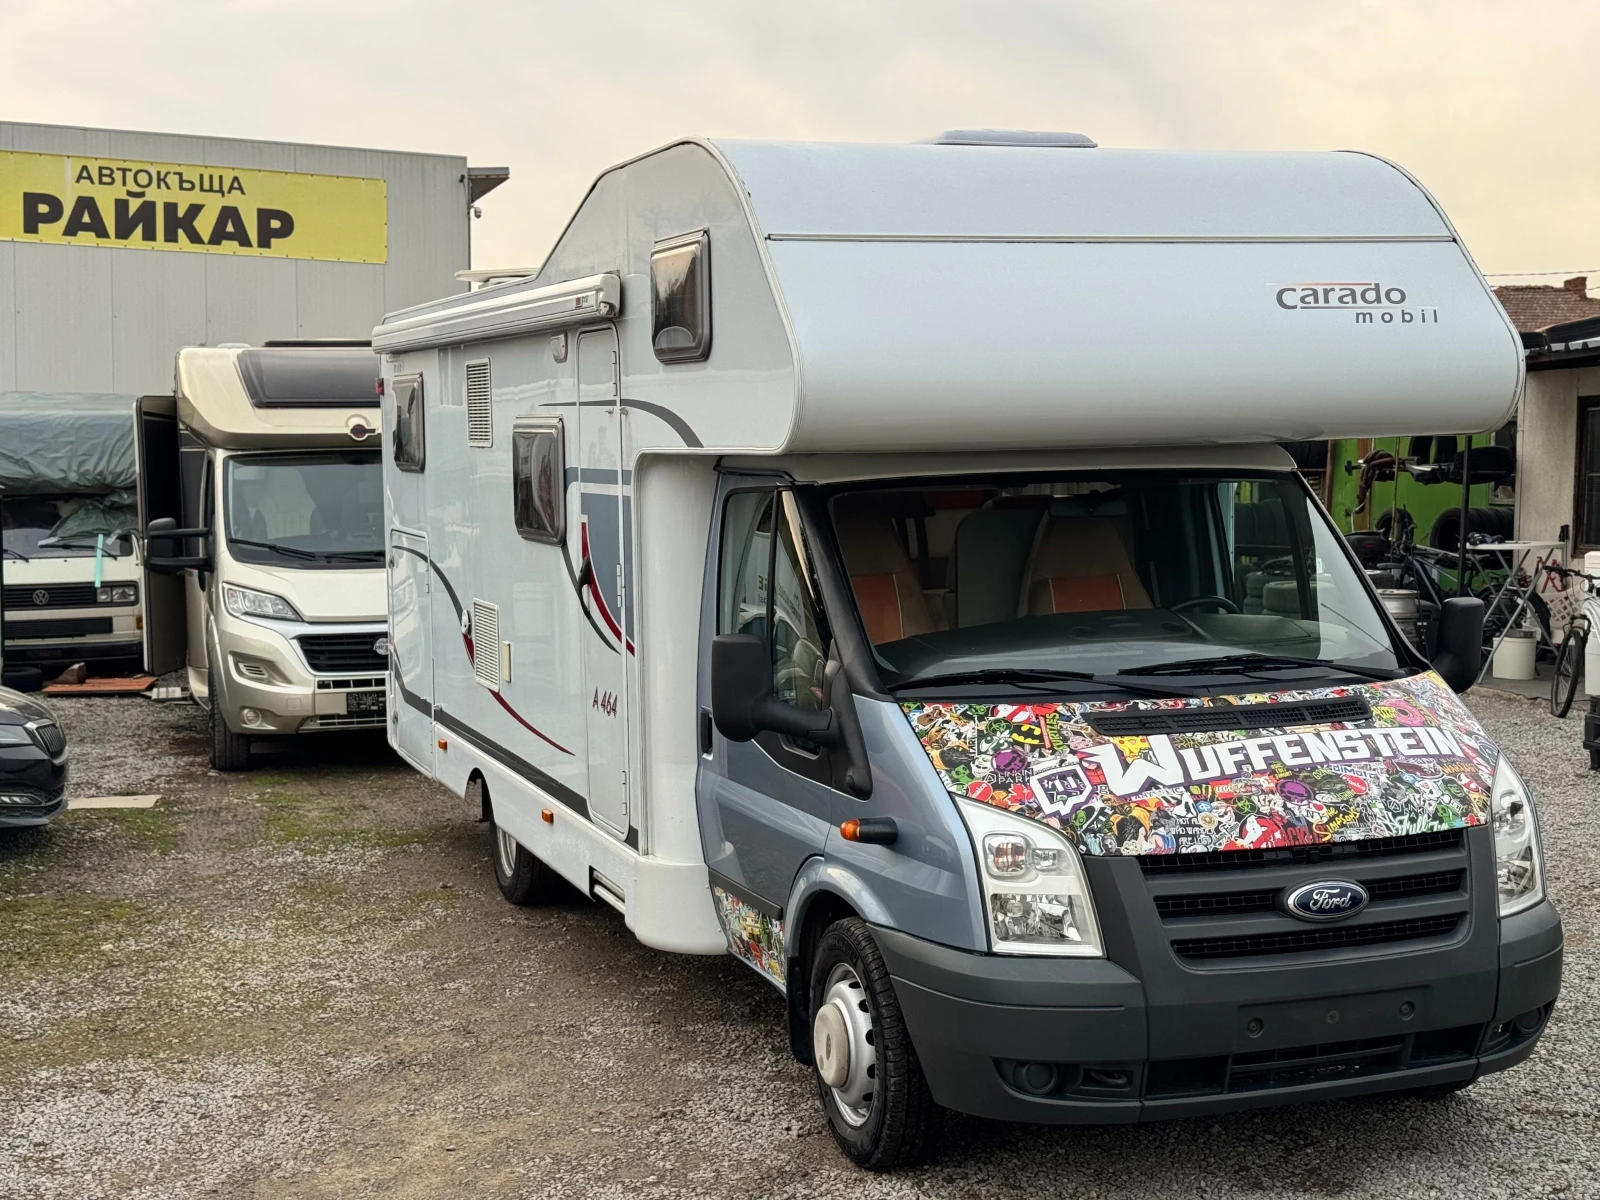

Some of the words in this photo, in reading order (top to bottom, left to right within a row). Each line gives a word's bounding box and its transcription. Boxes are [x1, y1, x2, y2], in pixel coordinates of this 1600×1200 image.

[75, 165, 246, 197] АВТОКЪЩА
[23, 189, 295, 249] РАЙКАР
[1276, 283, 1407, 309] carado
[1355, 309, 1438, 323] mobil
[592, 686, 599, 711] A
[600, 690, 618, 719] 464
[1078, 726, 1466, 796] WUFFENSTEIN
[1309, 888, 1352, 910] Ford
